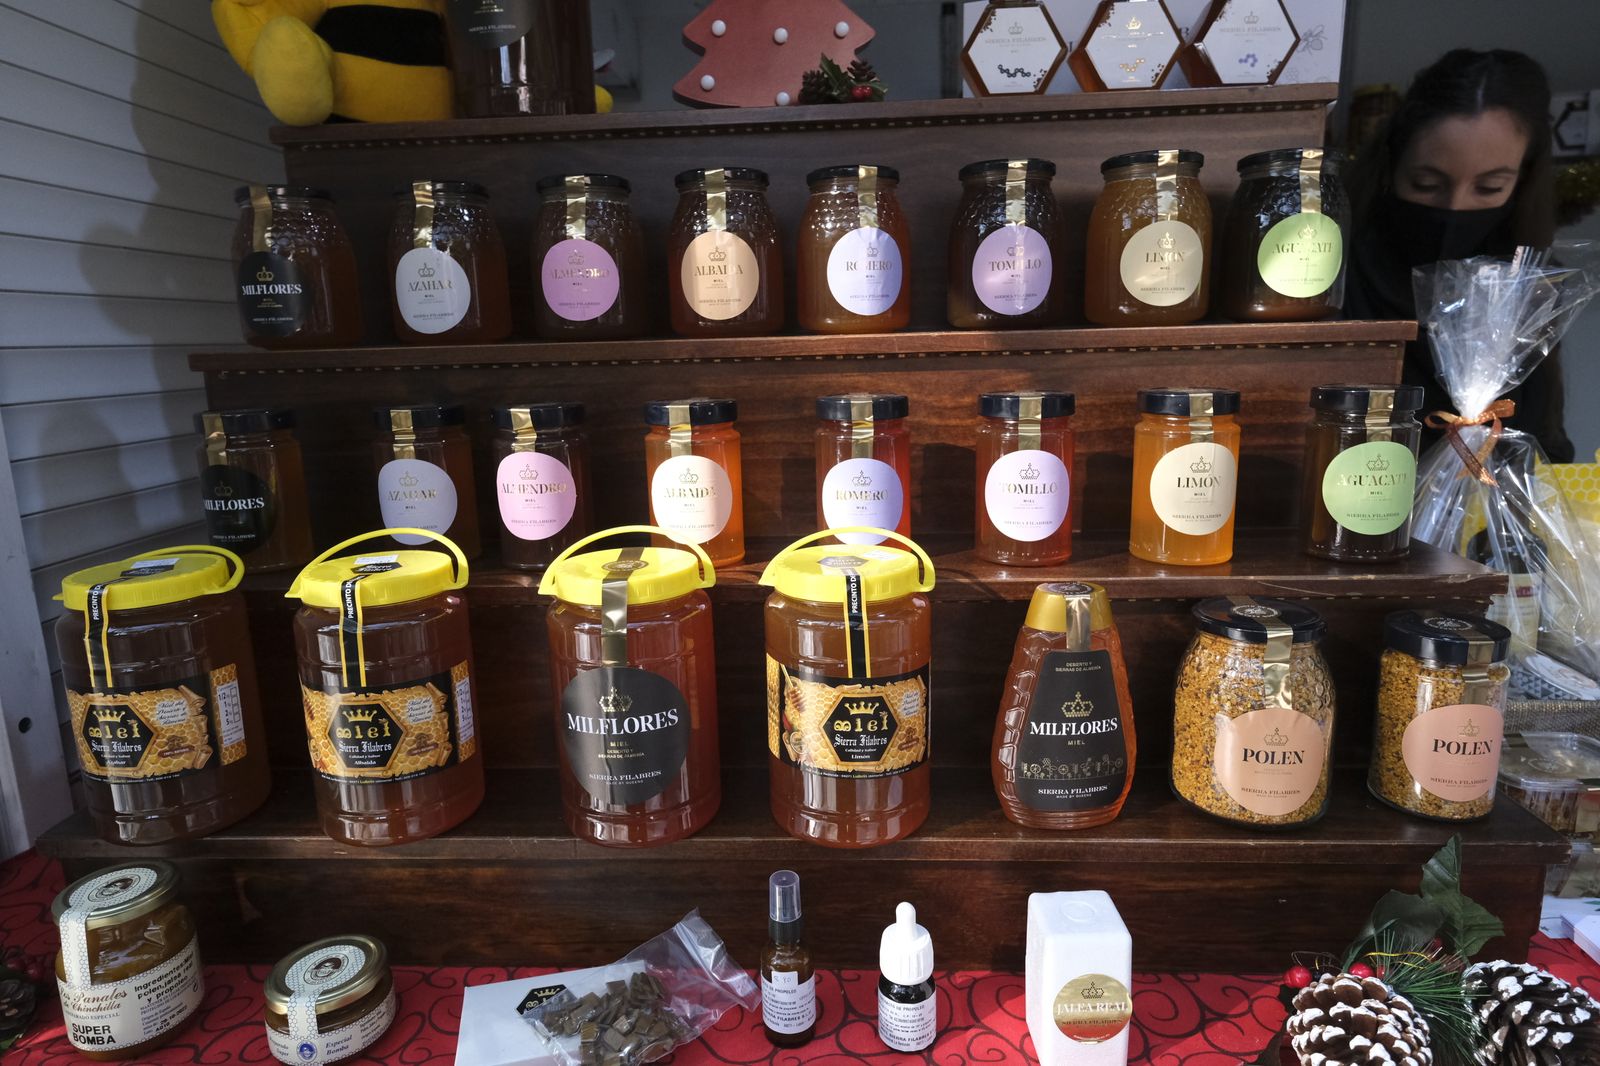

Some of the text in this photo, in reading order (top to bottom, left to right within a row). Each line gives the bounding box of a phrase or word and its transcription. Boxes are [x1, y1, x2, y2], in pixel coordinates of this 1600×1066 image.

[1272, 242, 1333, 255] AGUATE
[693, 264, 744, 277] ALBAIA
[989, 258, 1042, 272] TOMLO
[241, 283, 304, 296] MILFLORES
[407, 279, 453, 292] AZAHAR
[836, 488, 889, 501] ROMERO
[203, 497, 265, 511] MILFLORES
[346, 588, 355, 620] PRECINTO
[851, 581, 860, 614] PRECINTO
[92, 591, 100, 621] PRECINTO
[566, 708, 680, 736] MILFLORES
[1029, 717, 1119, 736] MILFLORES
[111, 740, 142, 753] Filabres
[338, 740, 392, 753] Sierra Filabres
[833, 733, 858, 748] Sierra
[859, 733, 888, 747] Filabres
[1431, 738, 1493, 756] POLEN
[1242, 747, 1305, 765] POLEN
[589, 769, 662, 782] SIERRA FILABRES
[1070, 785, 1109, 795] FILABRES
[1240, 786, 1301, 796] SIERRA FILABRES
[73, 987, 128, 1004] Panales
[71, 1000, 122, 1014] Chinchilla
[1057, 1001, 1129, 1016] JALEA REAL
[90, 1012, 120, 1021] ESPECIAL
[71, 1022, 112, 1035] SUPER
[72, 1032, 117, 1046] BOMBA
[325, 1034, 353, 1049] Especial
[326, 1044, 350, 1056] Bomba
